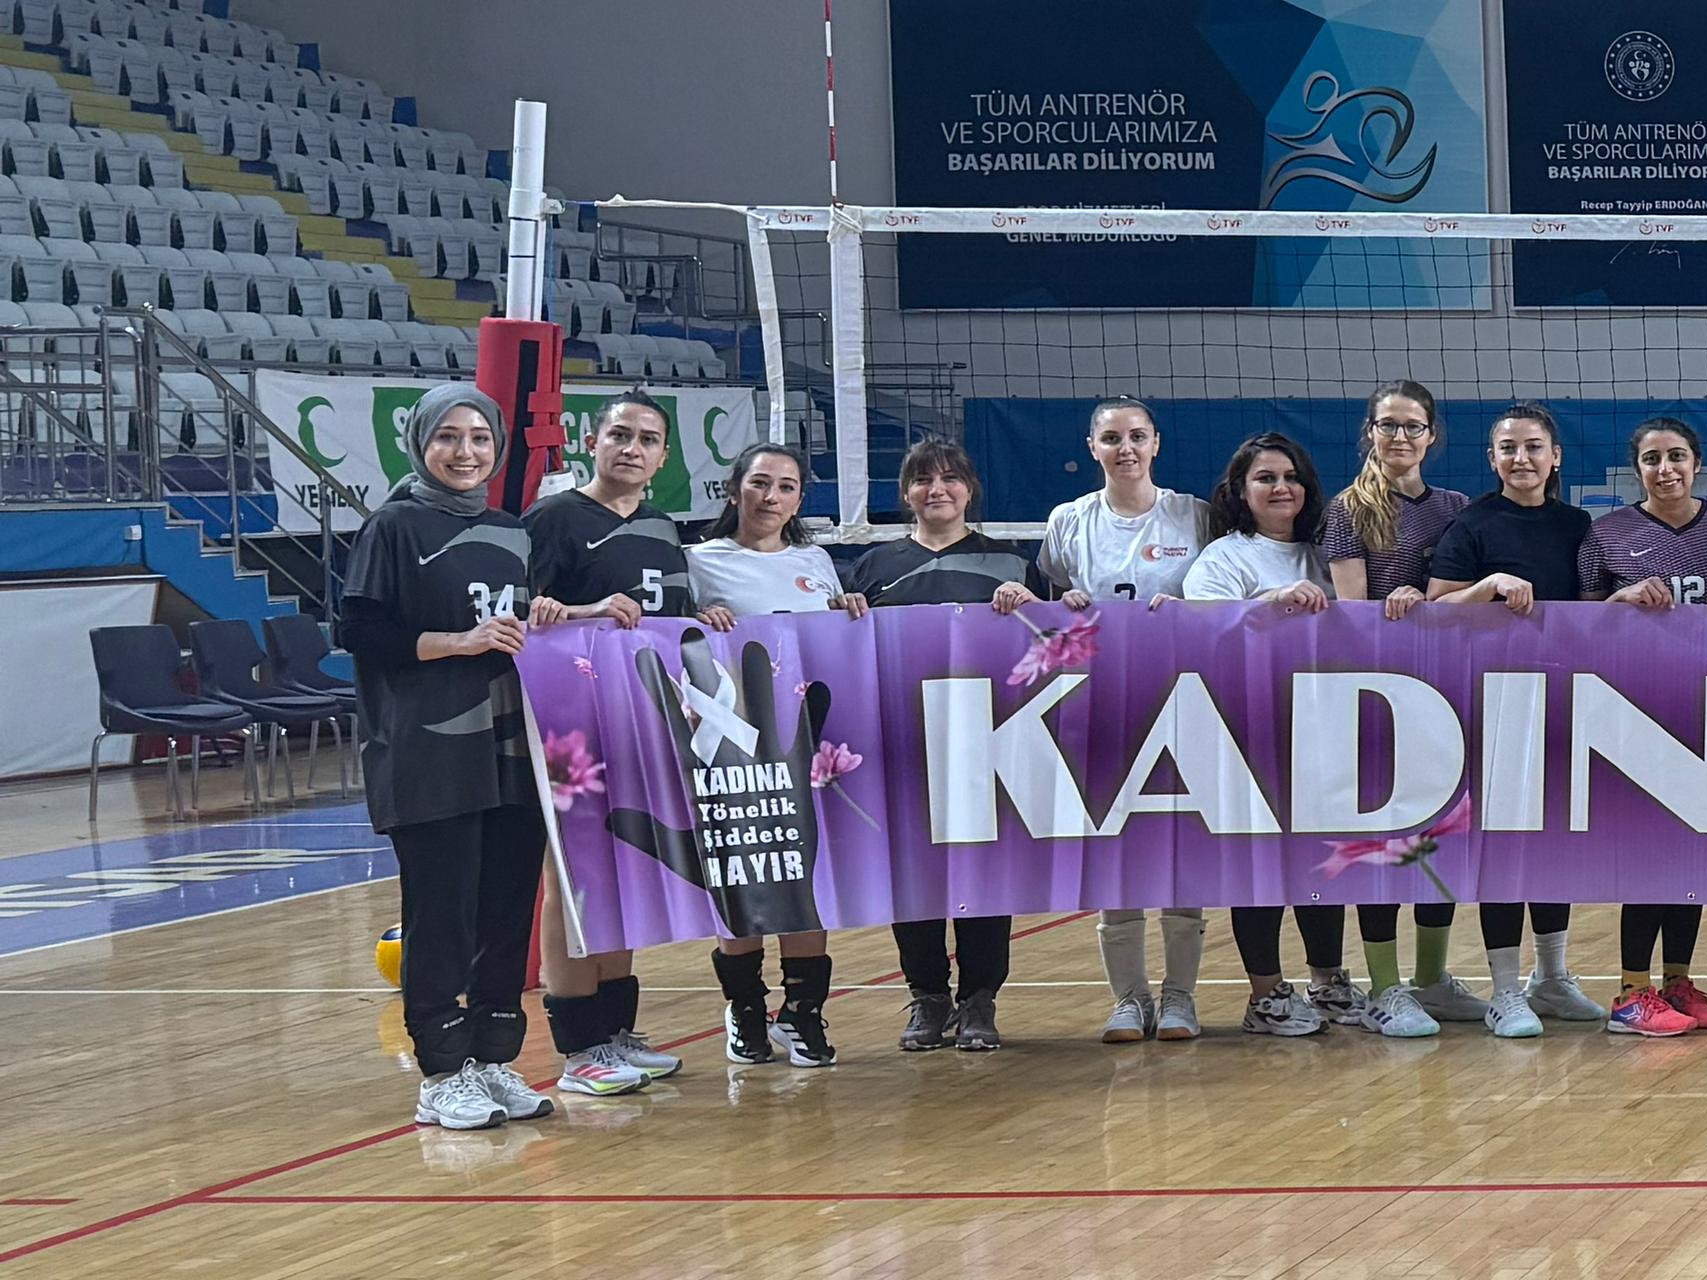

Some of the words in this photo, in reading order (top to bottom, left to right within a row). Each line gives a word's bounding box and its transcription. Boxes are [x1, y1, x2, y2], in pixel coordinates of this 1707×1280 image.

[970, 90, 1031, 116] TÜM
[1040, 89, 1186, 116] ANTRENÖR
[940, 122, 974, 144] VE
[981, 121, 1217, 144] SPORCULARIMIZA
[1564, 121, 1608, 140] TÜM
[948, 152, 1077, 175] BAŞARILAR
[1083, 148, 1215, 170] DİLİYORUM
[1543, 144, 1567, 160] VE
[1548, 166, 1641, 182] BAŞARILAR
[1581, 200, 1613, 211] Recep
[1616, 200, 1652, 211] Tayyip
[467, 582, 514, 624] 34
[642, 568, 663, 612] 5
[1671, 575, 1705, 605] 12
[693, 762, 793, 797] KADINA
[698, 797, 797, 822] Yönelik
[703, 826, 799, 852] Şiddete
[707, 850, 804, 888] HAYIR
